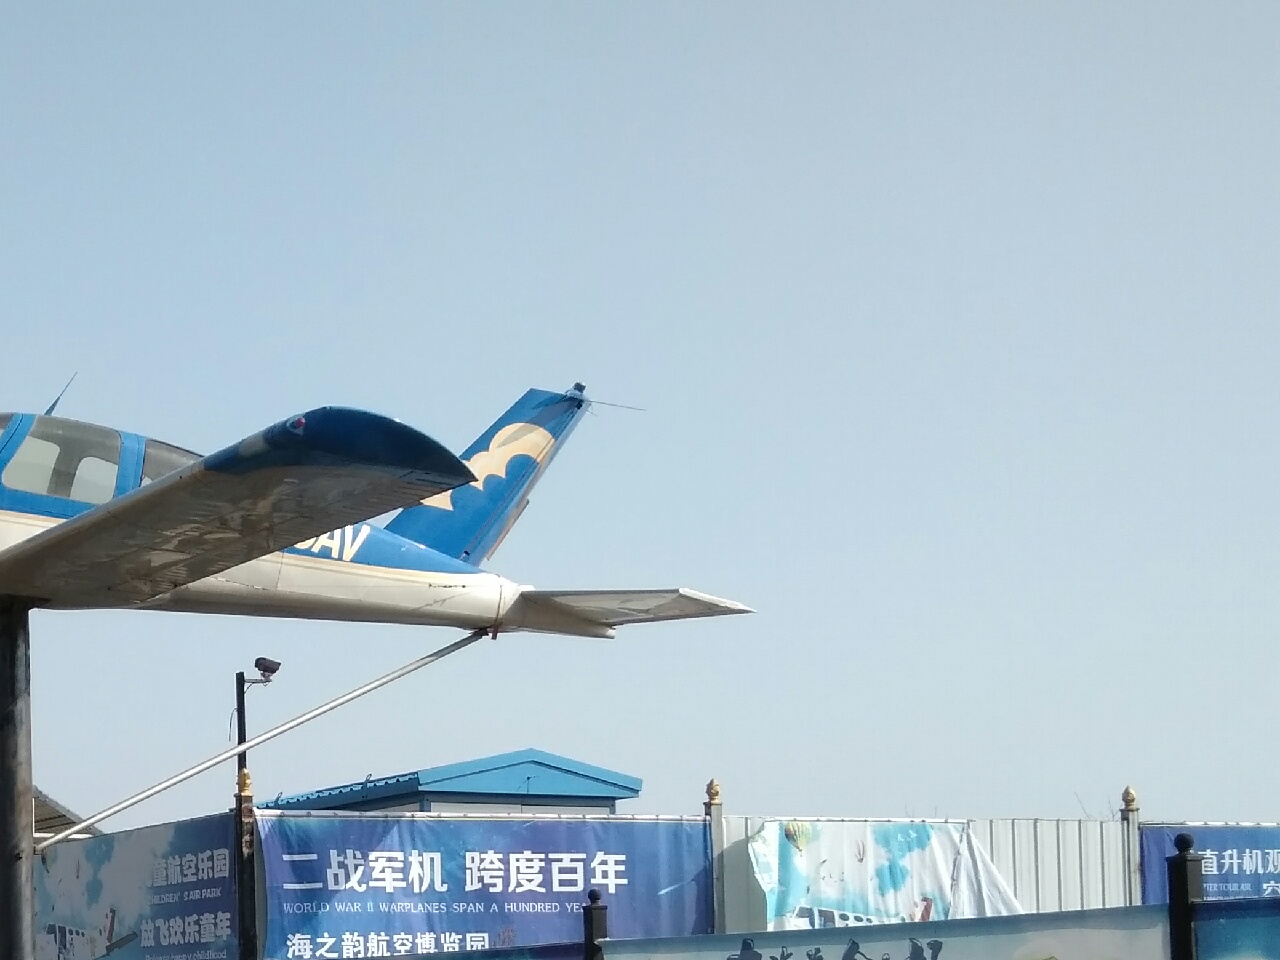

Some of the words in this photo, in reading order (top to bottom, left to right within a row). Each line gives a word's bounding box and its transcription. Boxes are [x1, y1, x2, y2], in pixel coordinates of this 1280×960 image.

[293, 524, 370, 562] AV
[145, 848, 229, 888] 童航空乐园
[282, 849, 448, 893] 二战军机
[465, 849, 629, 895] 跨度百年
[202, 887, 222, 899] PARK
[283, 902, 330, 914] WORLD
[335, 902, 362, 913] WAR
[379, 902, 447, 913] WARPLANES
[452, 902, 485, 913] SPAN
[490, 902, 499, 913] A
[504, 902, 560, 913] HUNDRED
[565, 902, 586, 913] YEA
[140, 911, 232, 948] 放飞欢乐童年
[286, 931, 490, 959] 海之韵航空博览园
